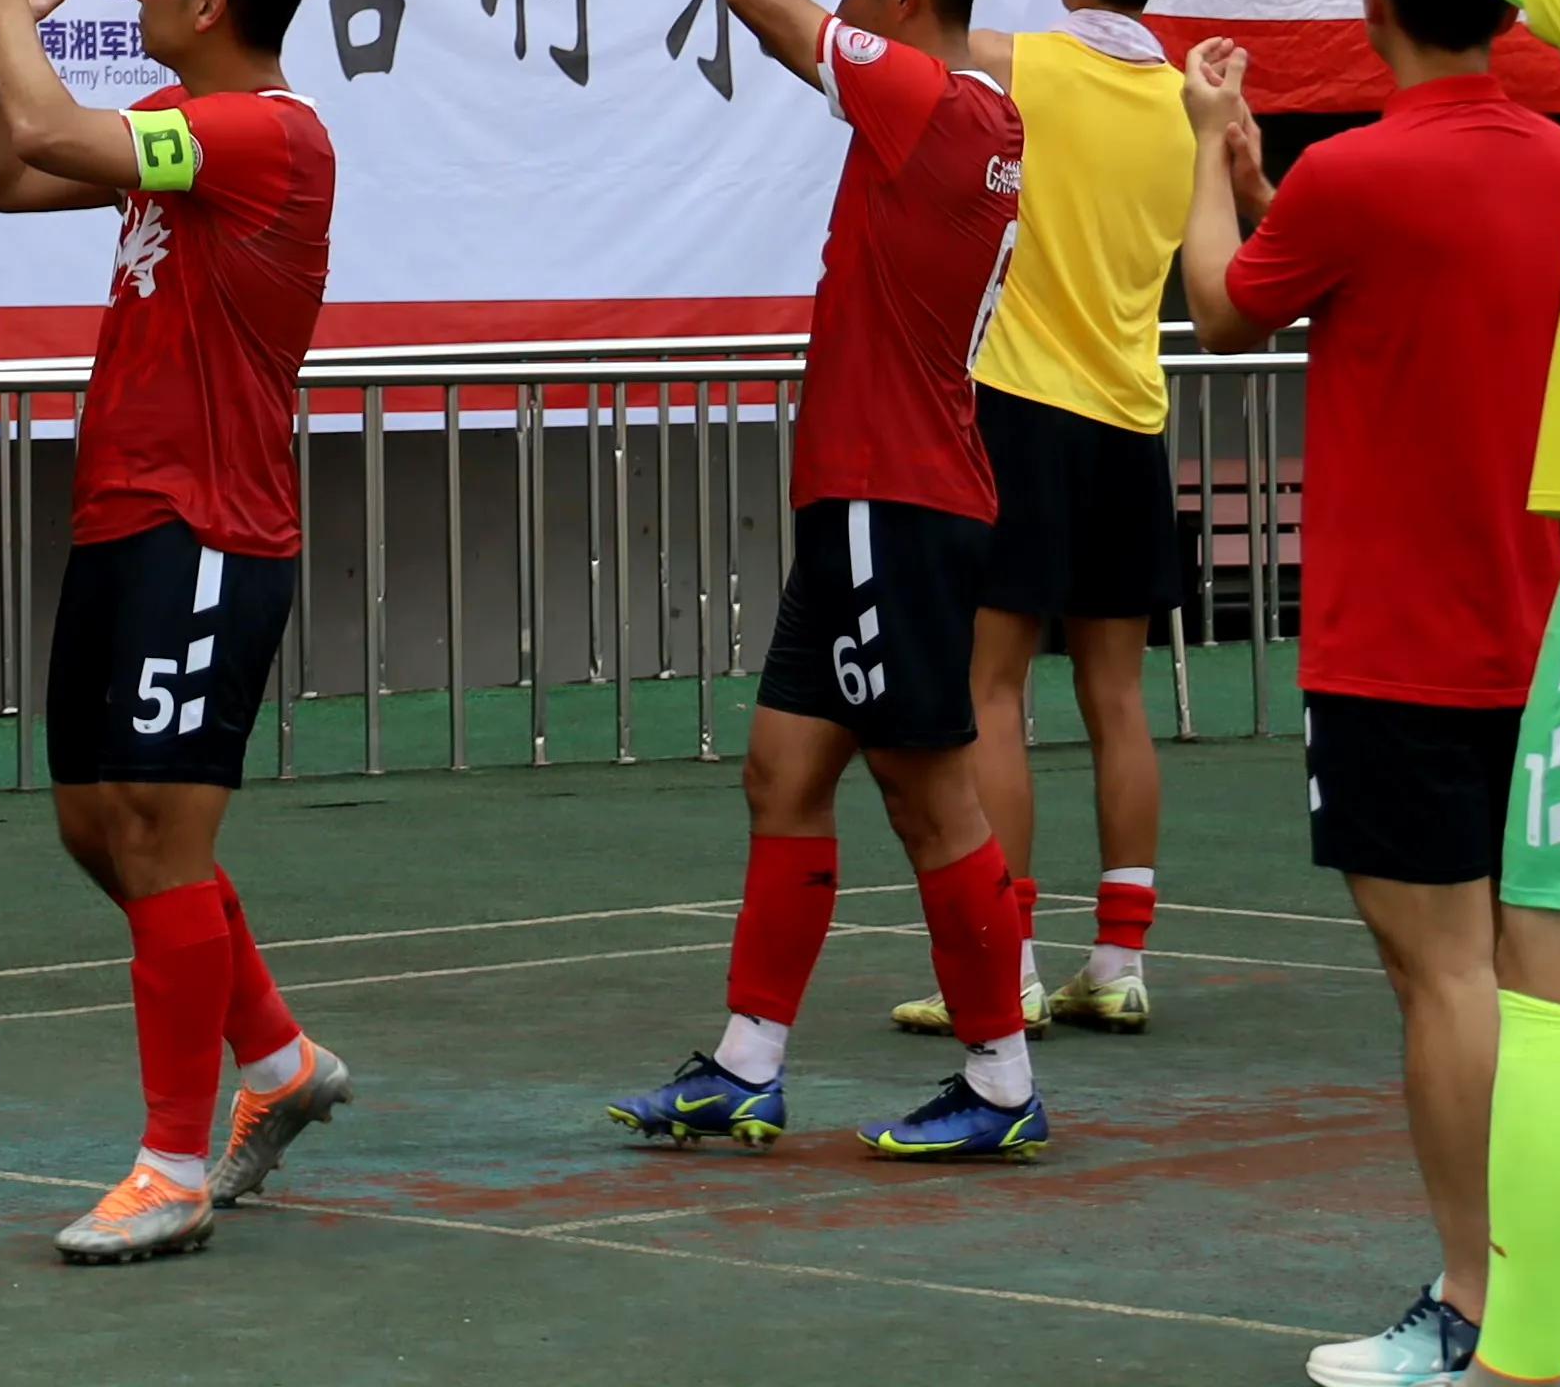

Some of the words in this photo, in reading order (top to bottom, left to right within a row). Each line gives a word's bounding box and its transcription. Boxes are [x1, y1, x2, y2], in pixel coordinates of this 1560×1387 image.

[58, 65, 99, 91] Army
[104, 63, 167, 86] Football
[143, 128, 184, 169] C
[131, 656, 179, 736] 5
[832, 633, 870, 707] 6
